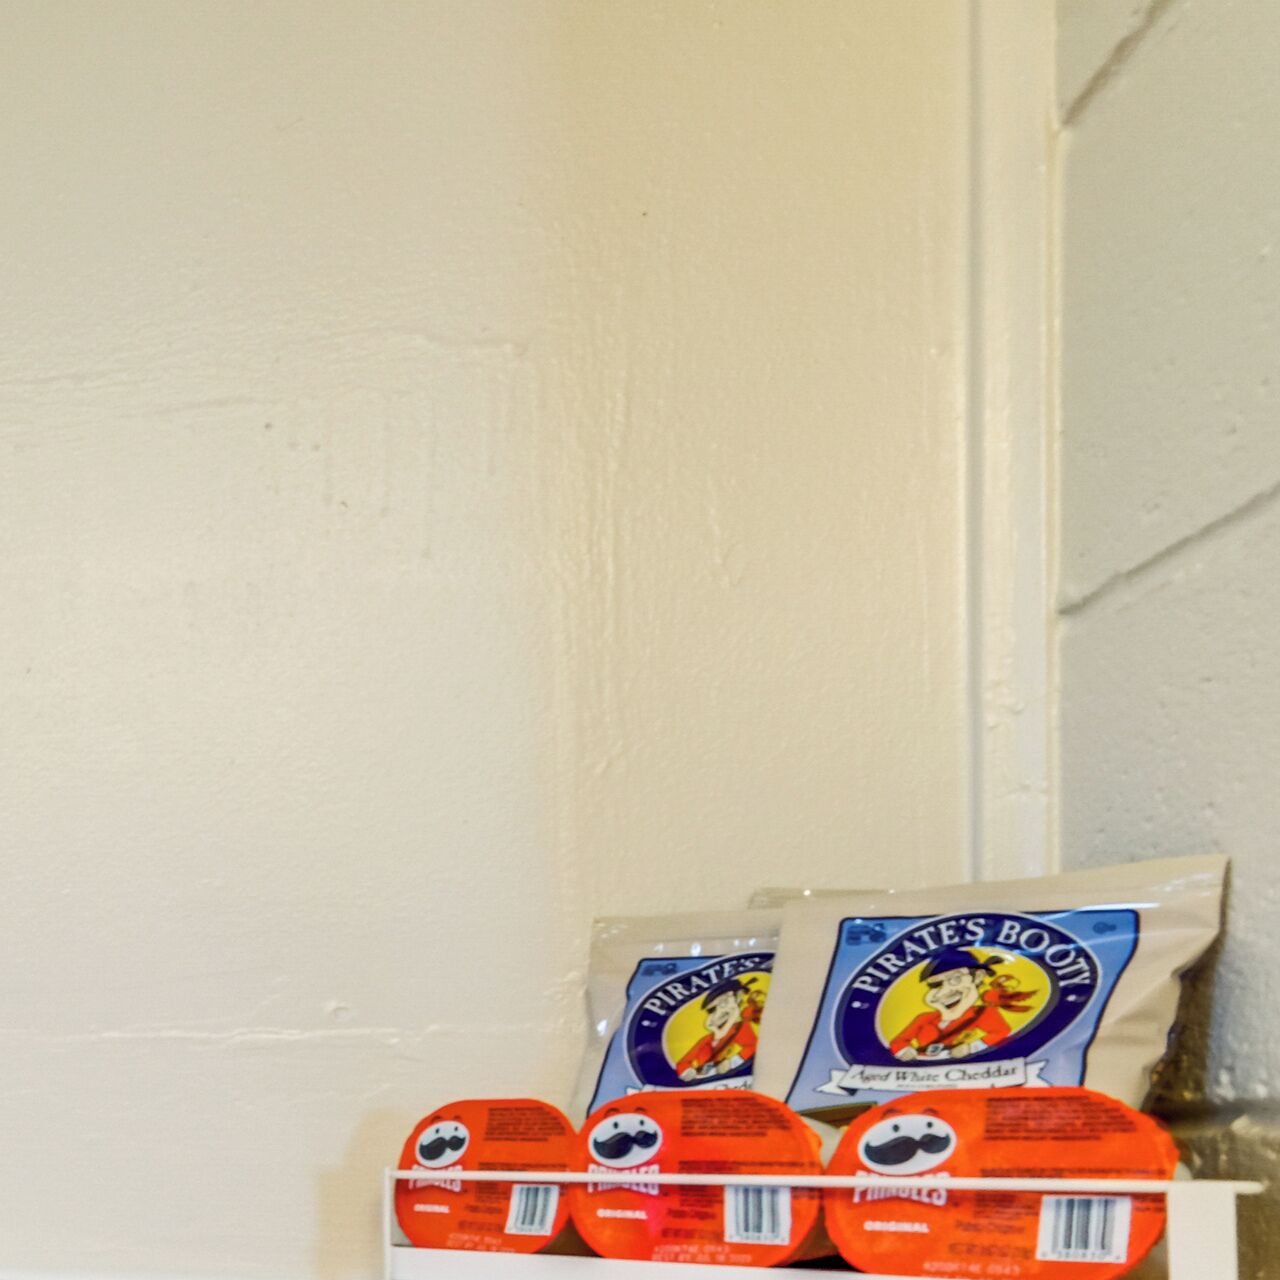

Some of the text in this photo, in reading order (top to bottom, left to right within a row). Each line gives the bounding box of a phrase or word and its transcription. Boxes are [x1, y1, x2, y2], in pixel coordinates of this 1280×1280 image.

[851, 917, 1094, 994] PIRATE'S BOOTY
[643, 956, 761, 1017] PIRATE'S
[850, 1063, 1019, 1084] Aged White Cheddar
[863, 1220, 930, 1234] ORIGINAL
